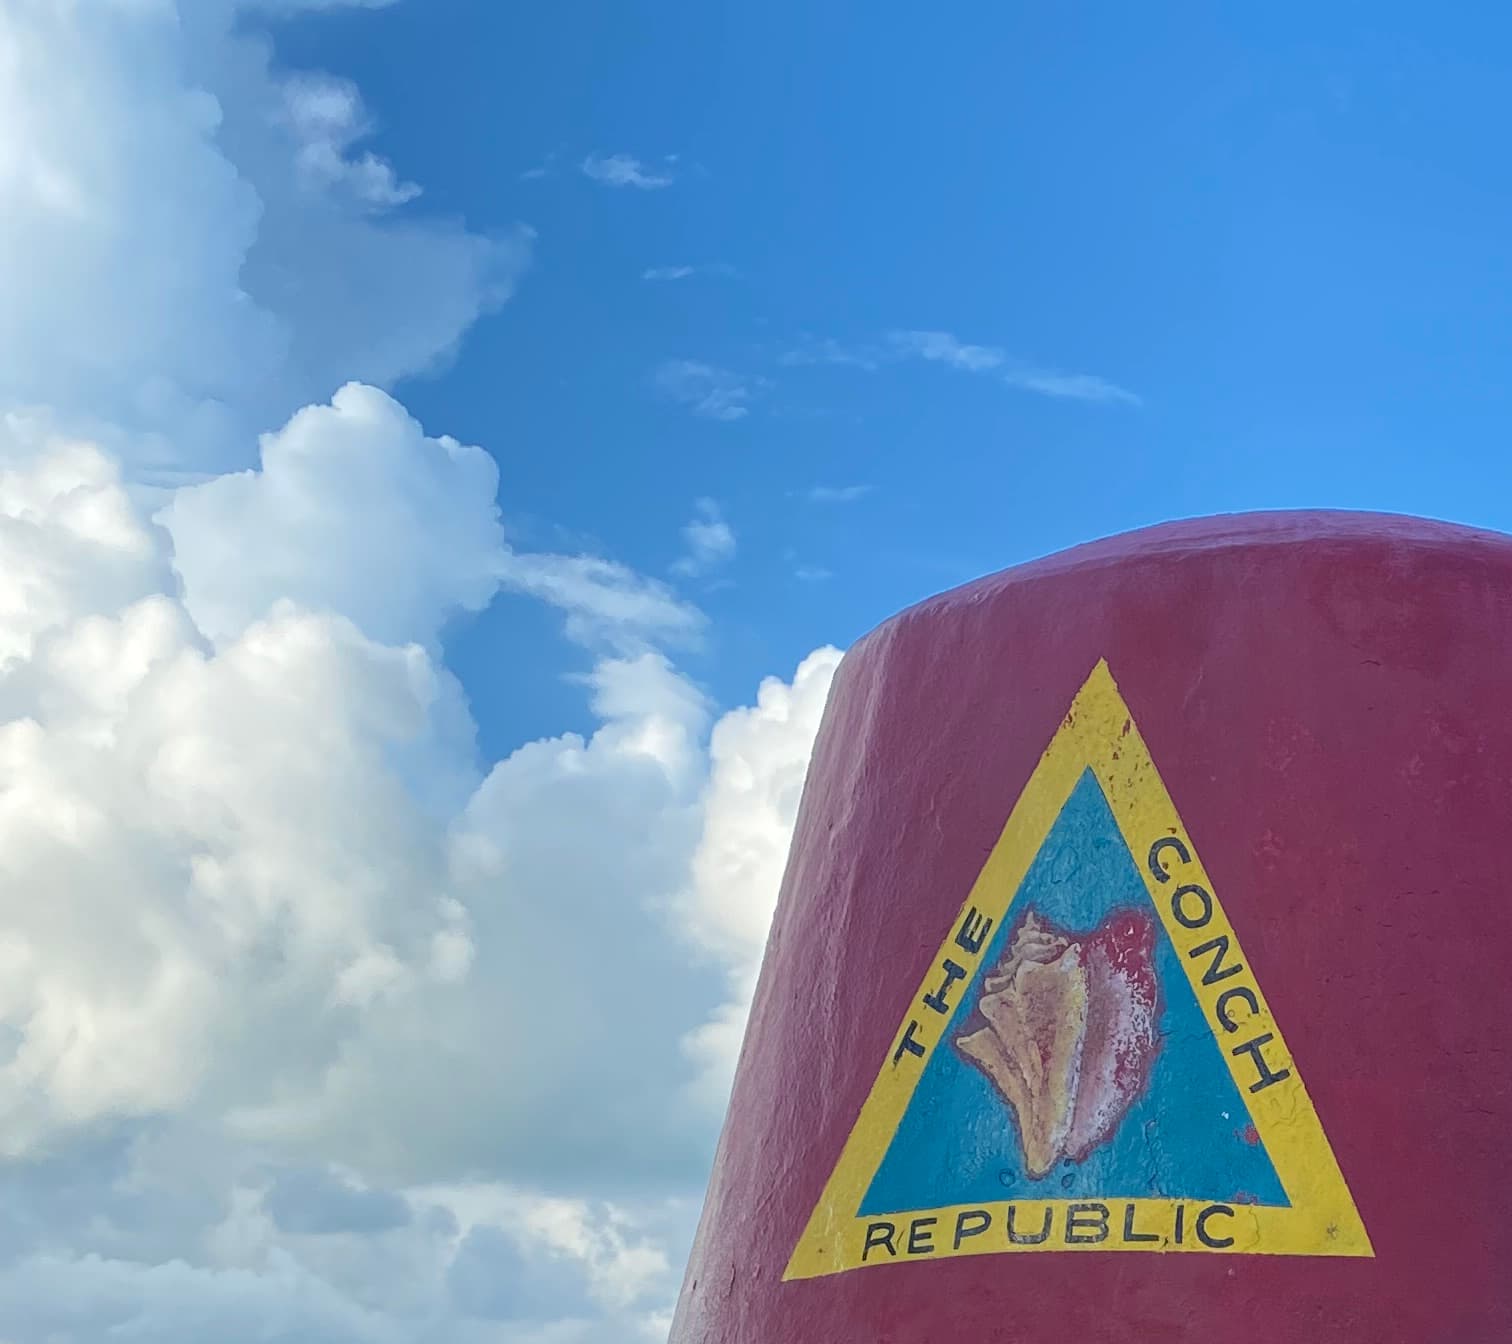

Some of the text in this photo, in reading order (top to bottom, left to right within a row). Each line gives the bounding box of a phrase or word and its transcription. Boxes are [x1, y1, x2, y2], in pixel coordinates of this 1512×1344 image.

[893, 906, 993, 1070] THE
[1148, 837, 1290, 1094] CONCH
[861, 1203, 1236, 1261] REPUBLIC
